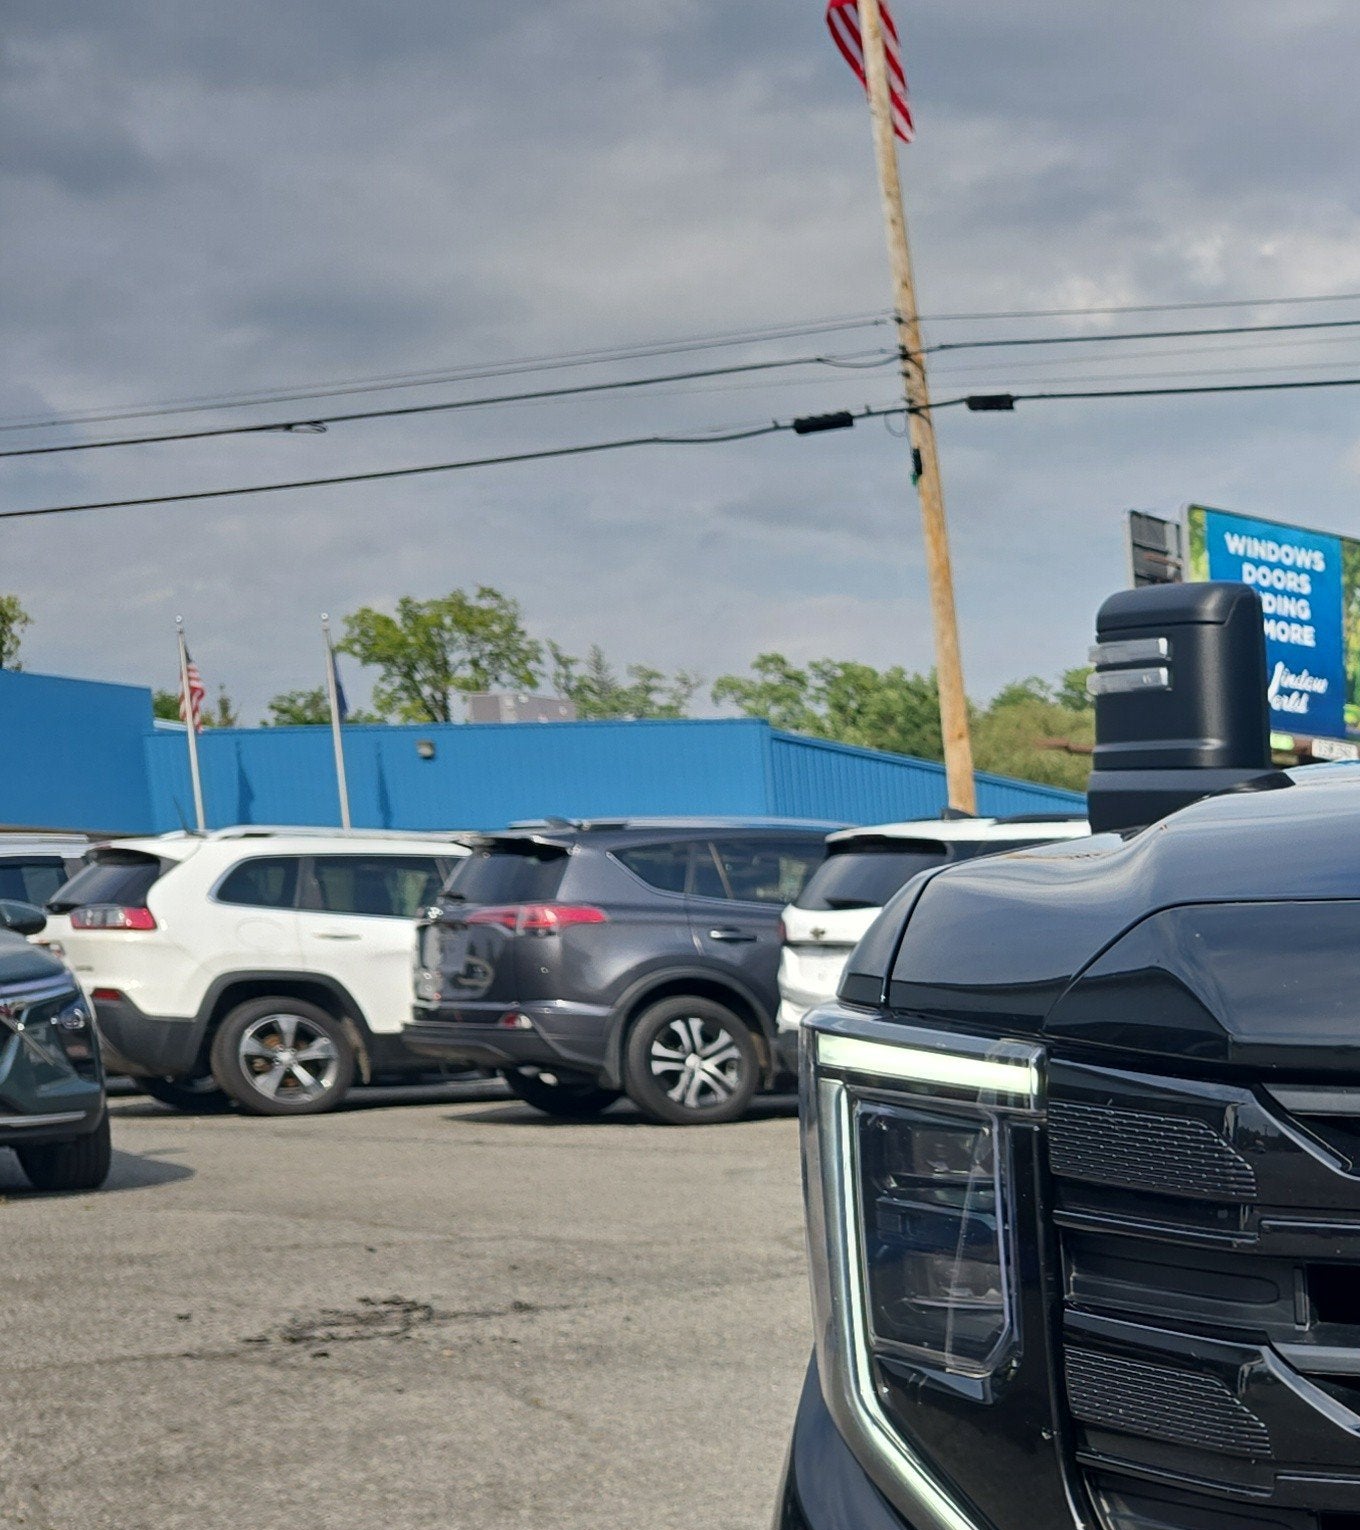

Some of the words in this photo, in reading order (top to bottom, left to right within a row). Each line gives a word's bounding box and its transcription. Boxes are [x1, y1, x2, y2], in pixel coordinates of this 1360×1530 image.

[1224, 531, 1326, 572] WINDOWS
[1242, 561, 1312, 595] DOORS
[1260, 591, 1312, 620] DING
